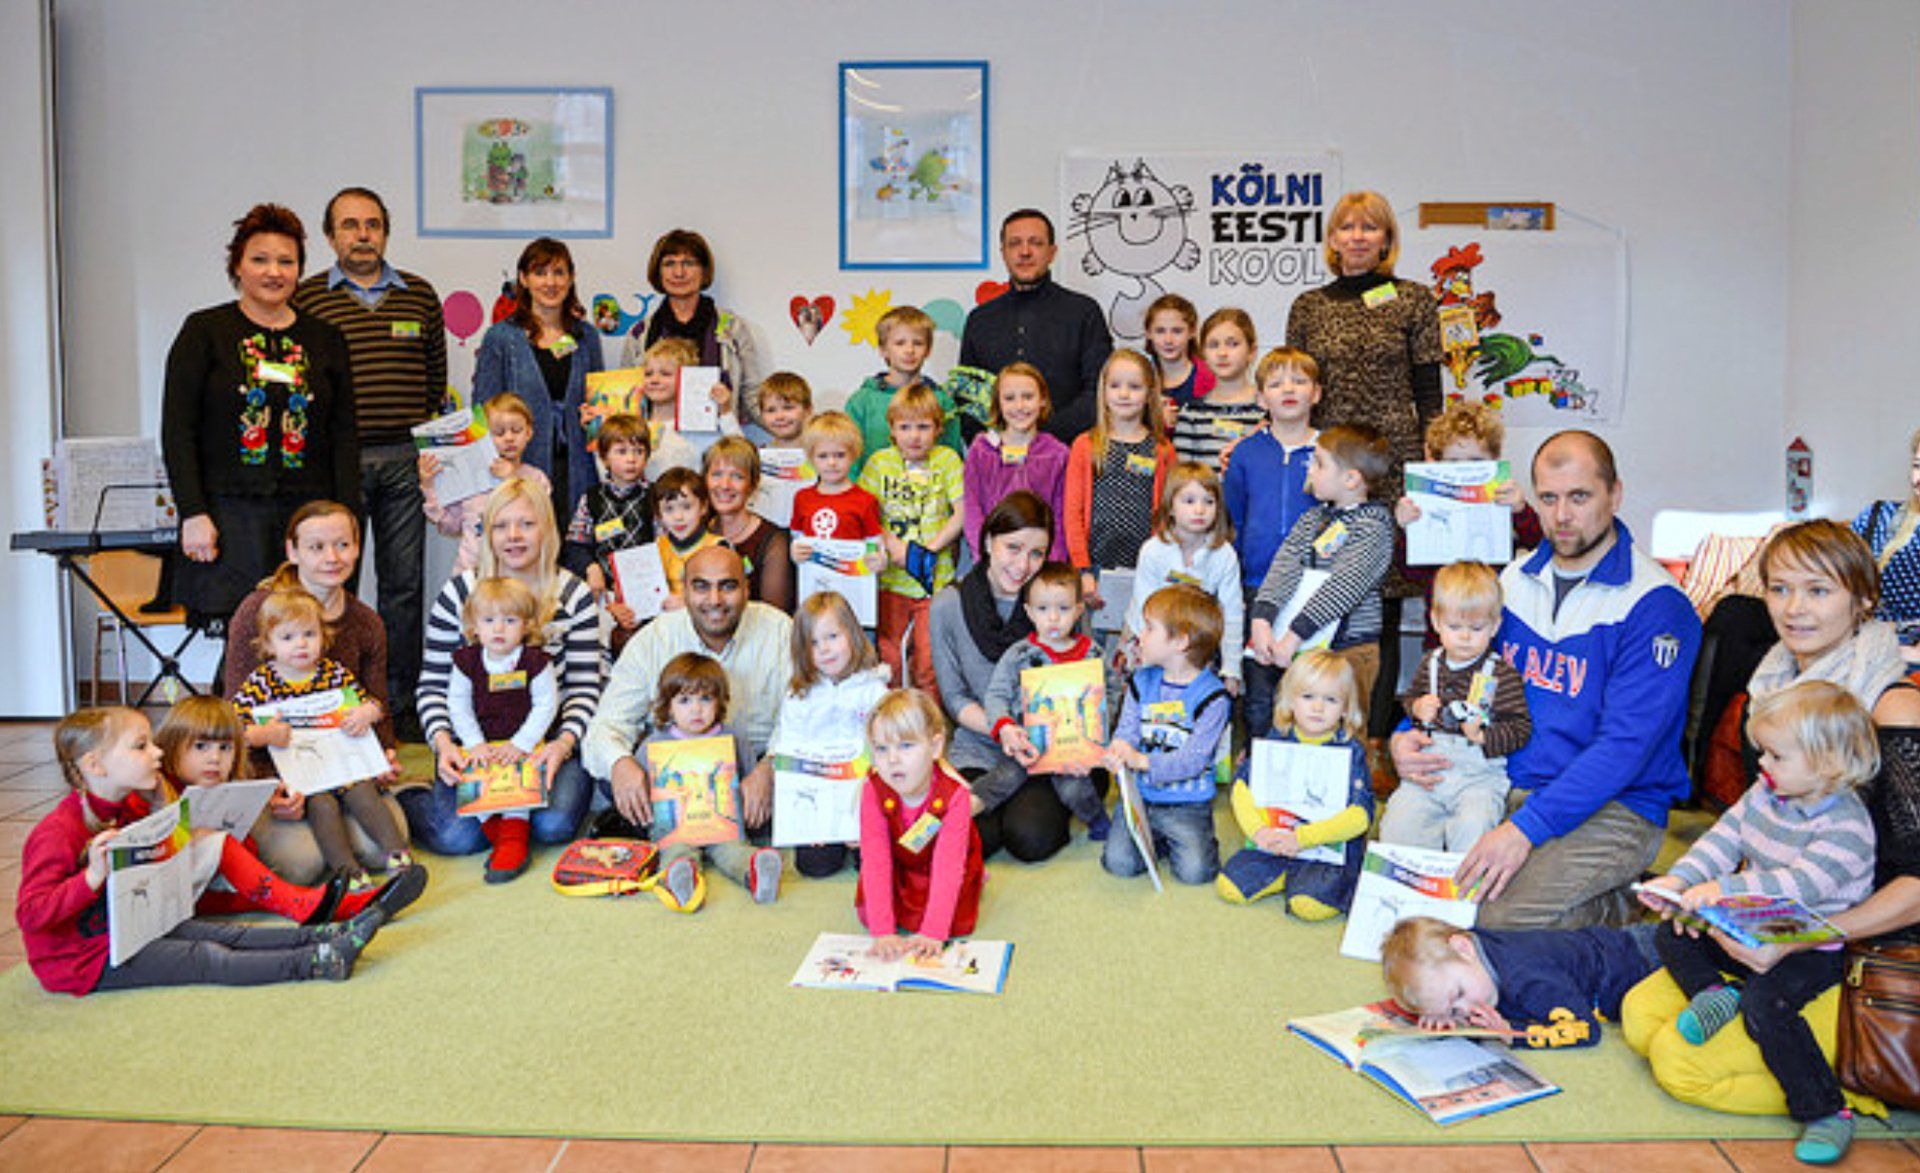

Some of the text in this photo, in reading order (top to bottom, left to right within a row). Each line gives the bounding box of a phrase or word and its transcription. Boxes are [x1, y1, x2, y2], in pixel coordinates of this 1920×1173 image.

[1211, 211, 1322, 243] EESTI
[1209, 247, 1326, 285] KOOL
[1502, 640, 1587, 698] KALEV
